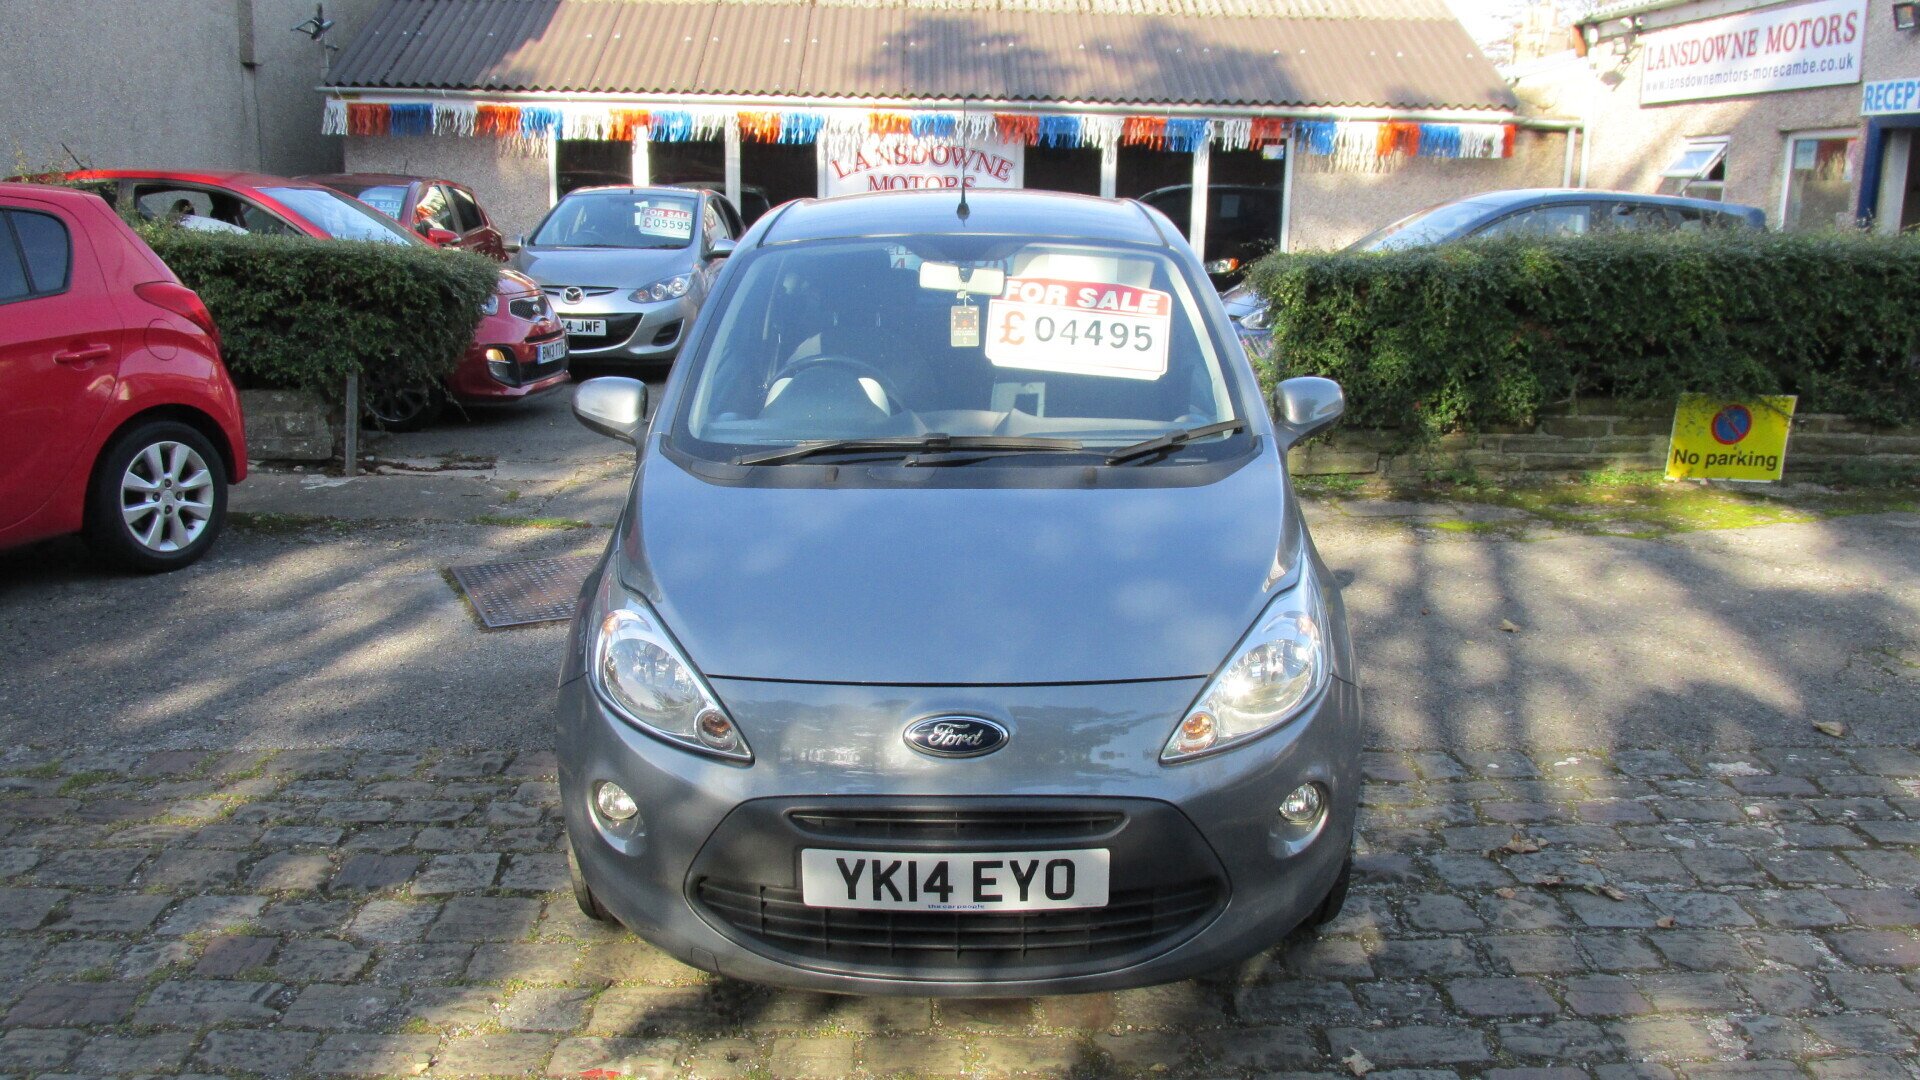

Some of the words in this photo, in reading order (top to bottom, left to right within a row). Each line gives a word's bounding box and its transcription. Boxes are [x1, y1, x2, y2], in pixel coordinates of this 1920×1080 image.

[1647, 27, 1759, 71] LANSDOWNE
[1765, 10, 1858, 54] MOTORS
[1646, 52, 1854, 91] www.lansdownemotors-morecambe.co.uk
[831, 143, 1015, 182] LANSDOWNE
[868, 175, 976, 191] MOTORS
[644, 208, 665, 217] FOR
[667, 210, 693, 219] SALE
[1003, 279, 1068, 307] FOR
[1076, 287, 1162, 314] SALE
[577, 320, 601, 333] JWF
[1673, 449, 1700, 465] No
[1704, 450, 1778, 471] parking
[928, 722, 984, 746] Ford
[836, 857, 954, 902] YK14
[972, 858, 1076, 902] EYO
